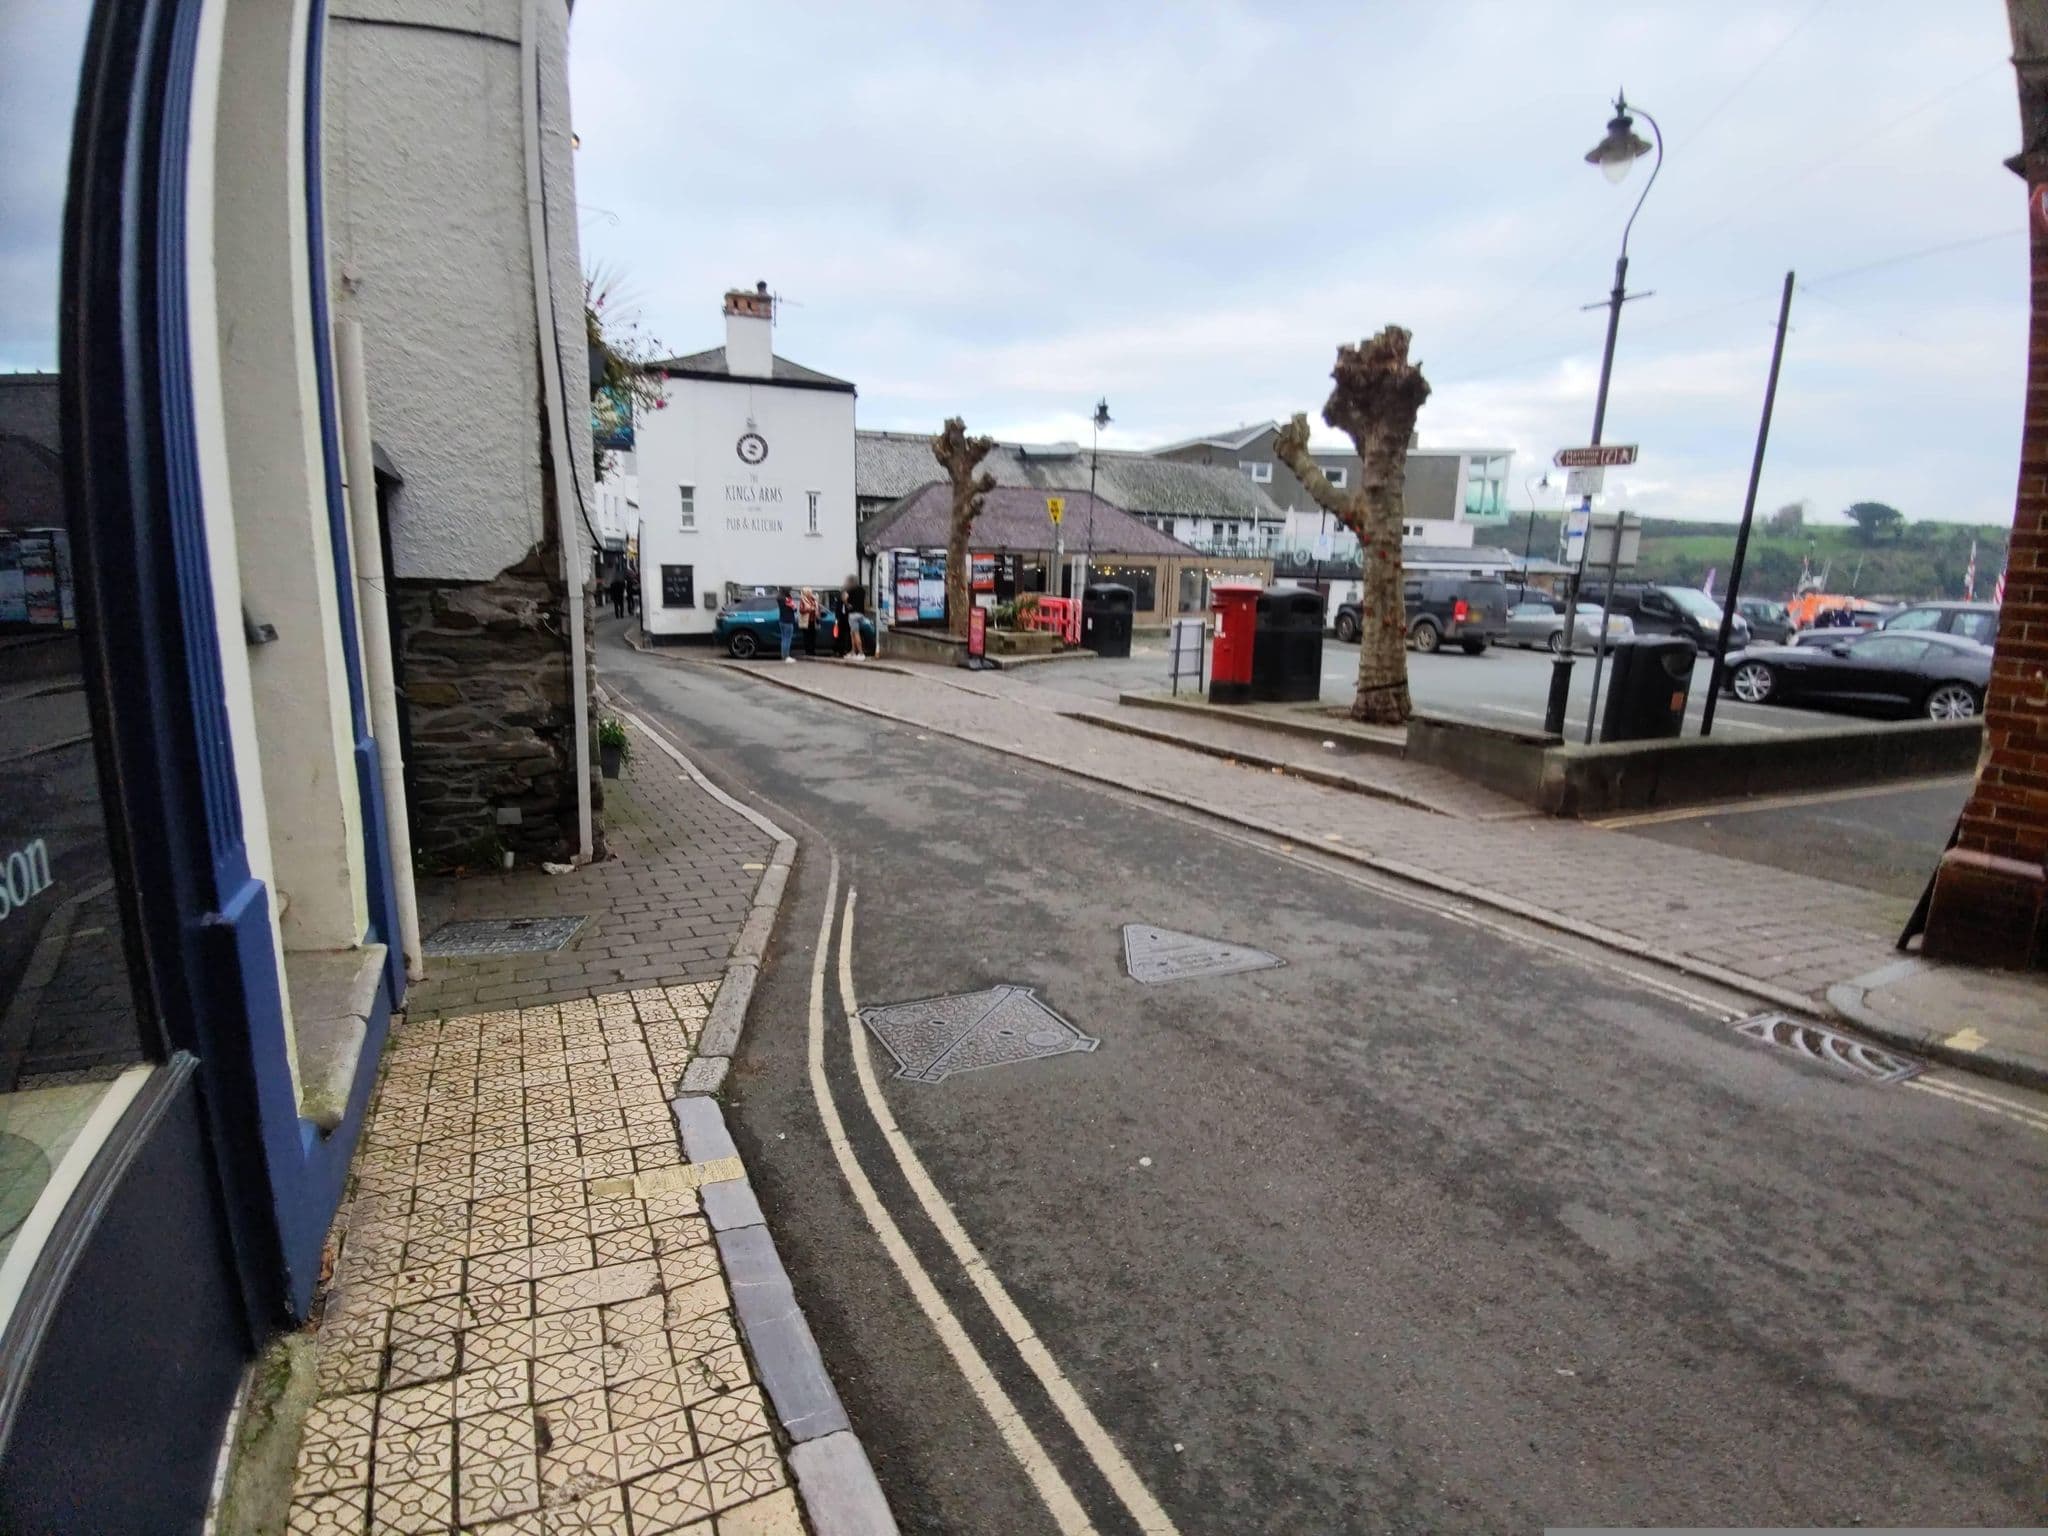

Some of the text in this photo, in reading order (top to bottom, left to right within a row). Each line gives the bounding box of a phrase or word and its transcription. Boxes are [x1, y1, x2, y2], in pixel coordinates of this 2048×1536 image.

[725, 484, 783, 503] KINGS ARMS
[726, 517, 741, 531] PUB
[751, 518, 783, 531] KITCHEN
